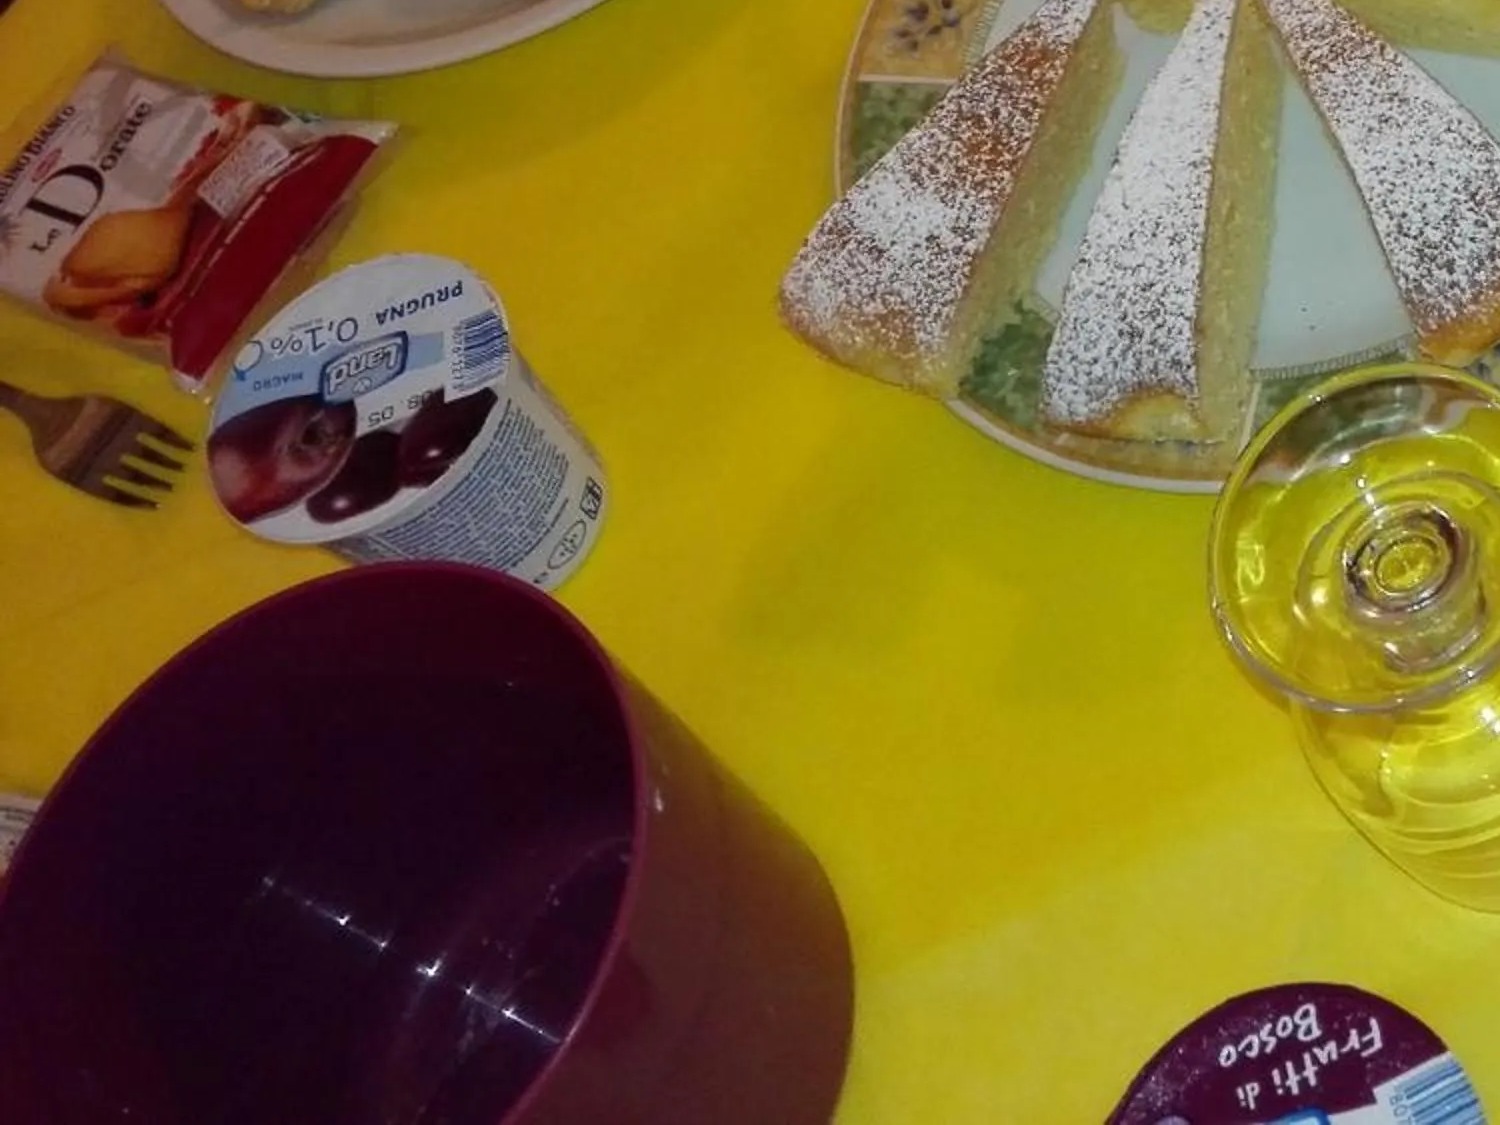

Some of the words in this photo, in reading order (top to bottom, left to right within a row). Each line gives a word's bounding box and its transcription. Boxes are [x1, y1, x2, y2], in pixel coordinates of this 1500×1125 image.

[25, 101, 153, 229] Dorate
[375, 279, 465, 327] PRUGNA
[270, 316, 360, 361] 0,1%
[325, 341, 402, 393] Land
[1217, 1002, 1324, 1068] Bosco
[1272, 1017, 1385, 1097] Frutti
[1236, 1081, 1262, 1110] di
